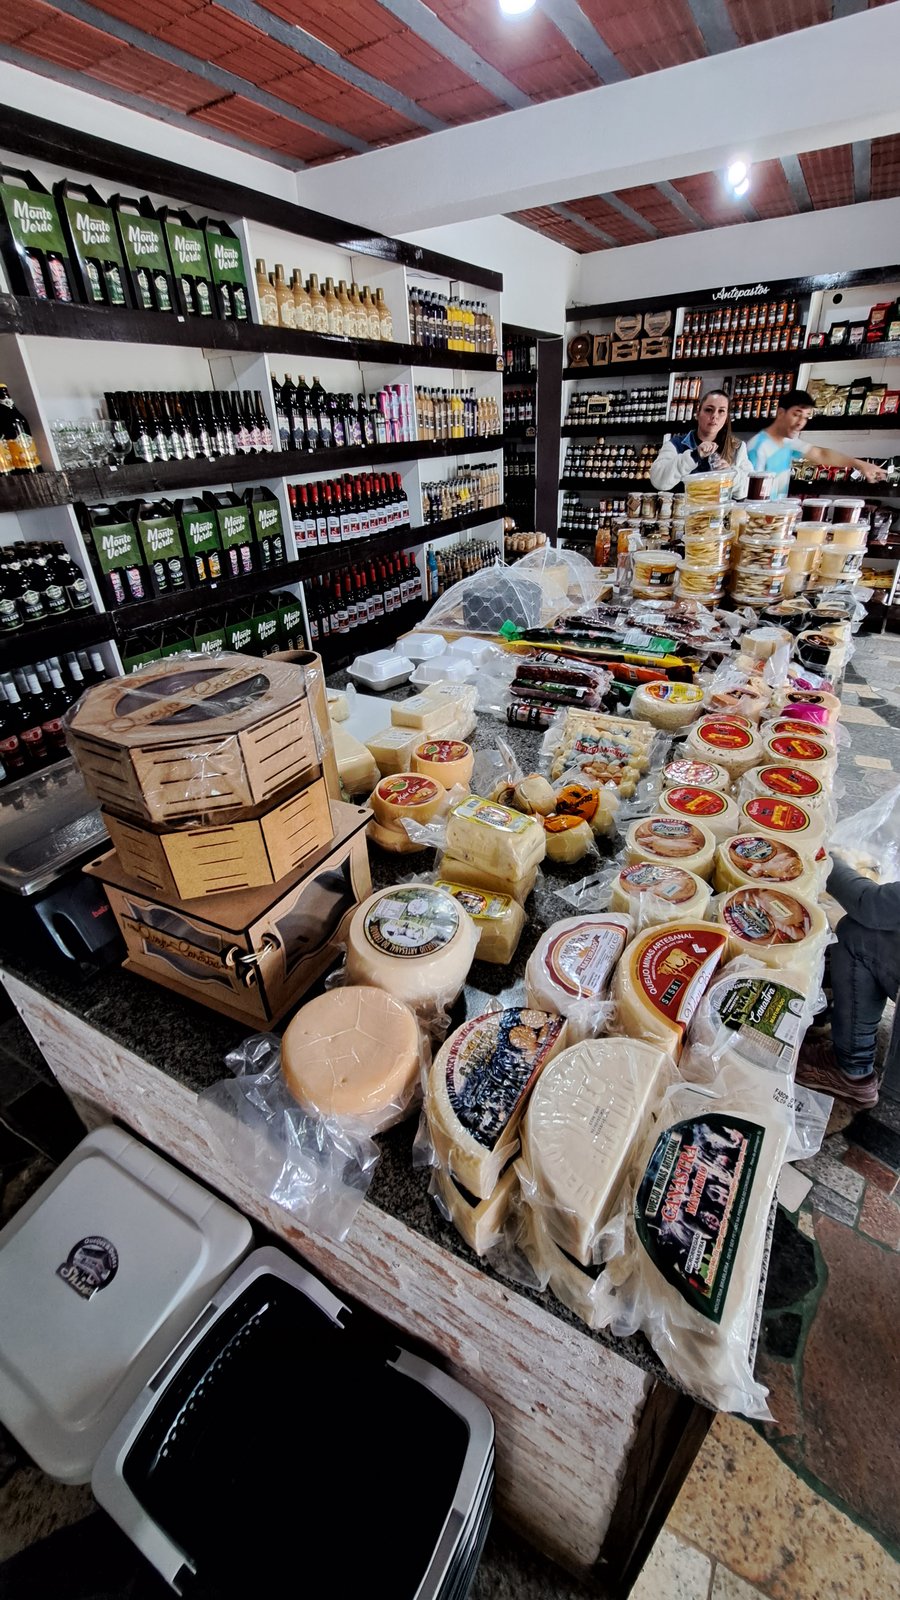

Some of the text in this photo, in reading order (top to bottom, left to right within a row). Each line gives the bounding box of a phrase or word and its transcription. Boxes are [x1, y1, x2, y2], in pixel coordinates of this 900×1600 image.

[14, 199, 52, 220] Monte
[21, 218, 52, 233] Verde
[76, 213, 110, 232] Monte
[82, 230, 110, 245] Verde
[129, 225, 158, 243] Monte
[134, 240, 158, 255] Verde
[175, 235, 200, 252] Monte
[179, 251, 200, 263] Verde
[215, 244, 238, 260] Monte
[219, 258, 238, 270] Verde
[712, 284, 770, 300] Antepastos
[224, 516, 245, 530] Monte
[258, 509, 277, 522] Monte
[190, 522, 213, 536] Monte
[227, 524, 245, 537] Verde
[261, 517, 277, 530] Verde
[103, 533, 131, 550] Monte
[147, 527, 174, 543] Monte
[194, 531, 213, 544] Verde
[152, 537, 174, 551] Verde
[107, 544, 131, 560] Verde
[283, 610, 300, 624] Monte
[286, 617, 300, 630] Verde
[258, 620, 276, 633] Monte
[260, 626, 276, 640] Verde
[232, 629, 251, 643] Monte
[235, 636, 251, 650] Verde
[389, 944, 418, 955] ARTESANAL
[642, 933, 694, 995] QUEIJO MINAS ARTESANAL
[749, 984, 775, 1023] Canastra
[770, 998, 785, 1024] MATURADO
[647, 1138, 679, 1213] QUEIJO MINAS ARTESANAL
[661, 1145, 698, 1222] CANASTRA
[693, 1241, 706, 1269] CANASTRA
[719, 1262, 730, 1288] BRASILEIRA
